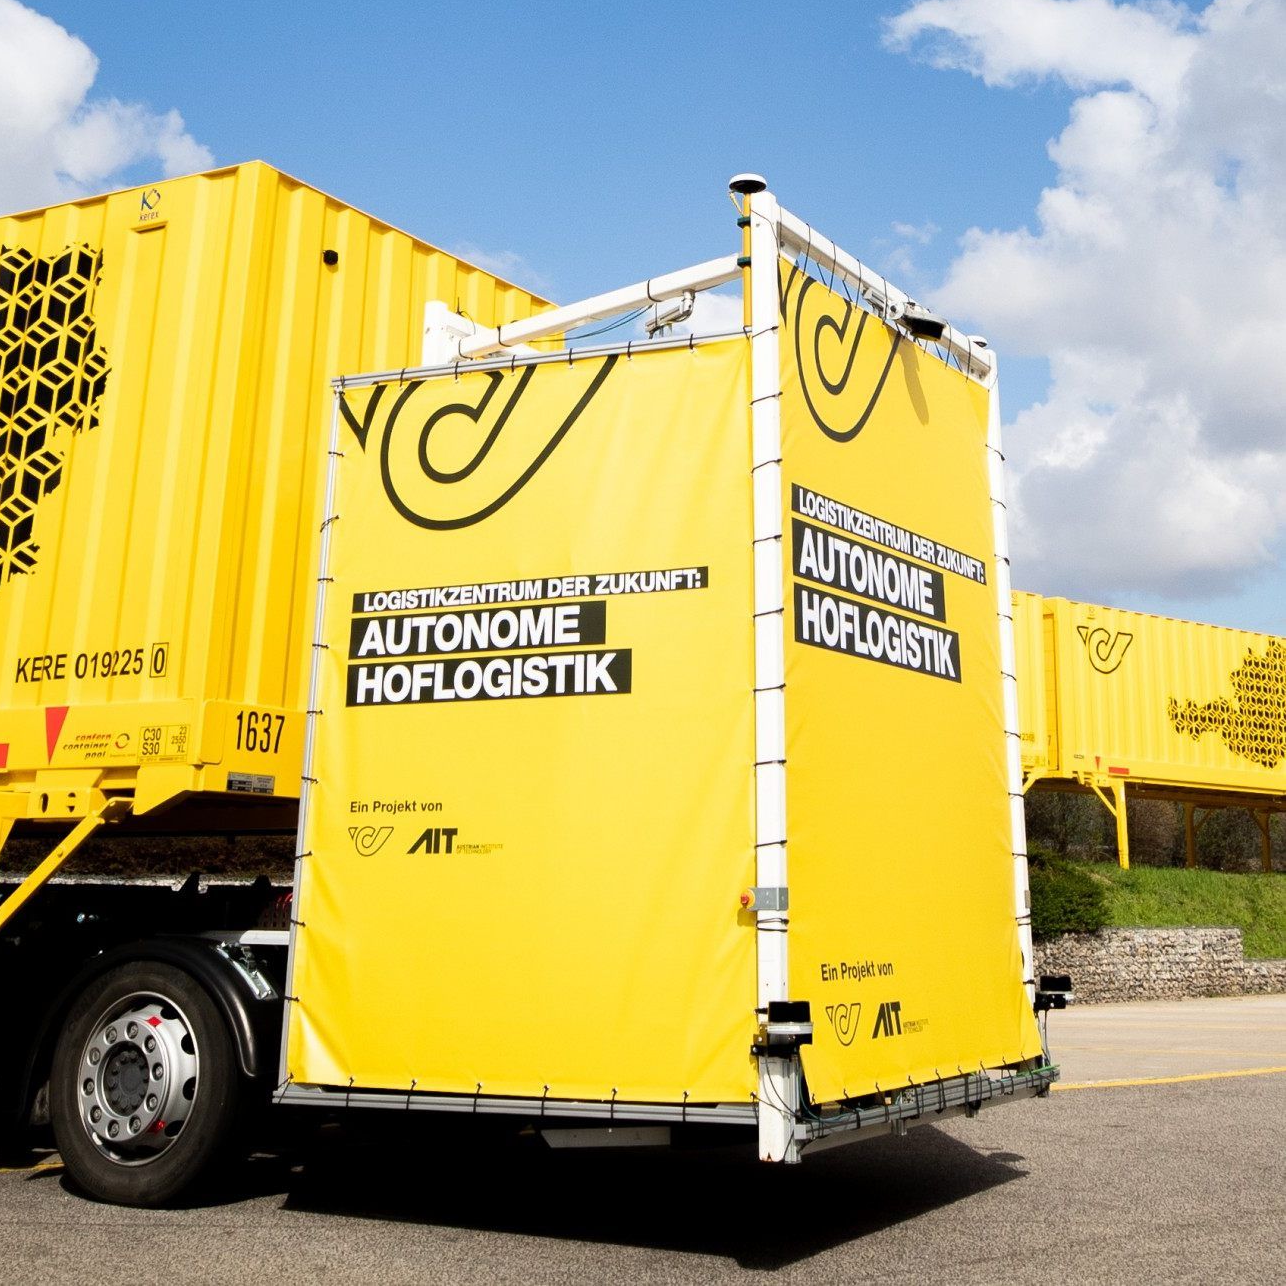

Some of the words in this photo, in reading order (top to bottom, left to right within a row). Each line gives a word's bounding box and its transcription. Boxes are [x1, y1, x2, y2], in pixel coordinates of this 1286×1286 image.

[799, 488, 910, 554] LOGISTIKZENTRUM
[913, 534, 935, 564] DER
[936, 544, 985, 584] ZUKUNFT:
[363, 580, 542, 612] LOGISTIKZENTRUM
[547, 576, 590, 598] DER
[595, 568, 701, 594] ZUKUNFT:
[799, 527, 934, 615] AUTONOME
[357, 605, 581, 656] AUTONOME
[801, 589, 956, 678] HOFLOGISTIK
[15, 654, 68, 683] KERE
[74, 649, 144, 679] 019225
[152, 645, 166, 676] 0
[356, 653, 618, 703] HOFLOGISTIK
[62, 742, 109, 750] container
[142, 742, 160, 755] S30
[143, 728, 162, 741] C30
[236, 710, 285, 754] 1637
[85, 751, 106, 760] pool
[350, 801, 368, 813] Ein
[373, 800, 417, 815] Projekt
[421, 802, 443, 812] von
[406, 828, 458, 854] AIT
[821, 963, 838, 981] Ein
[840, 960, 875, 982] Projekt
[877, 962, 894, 976] von
[872, 1001, 902, 1039] AIT
